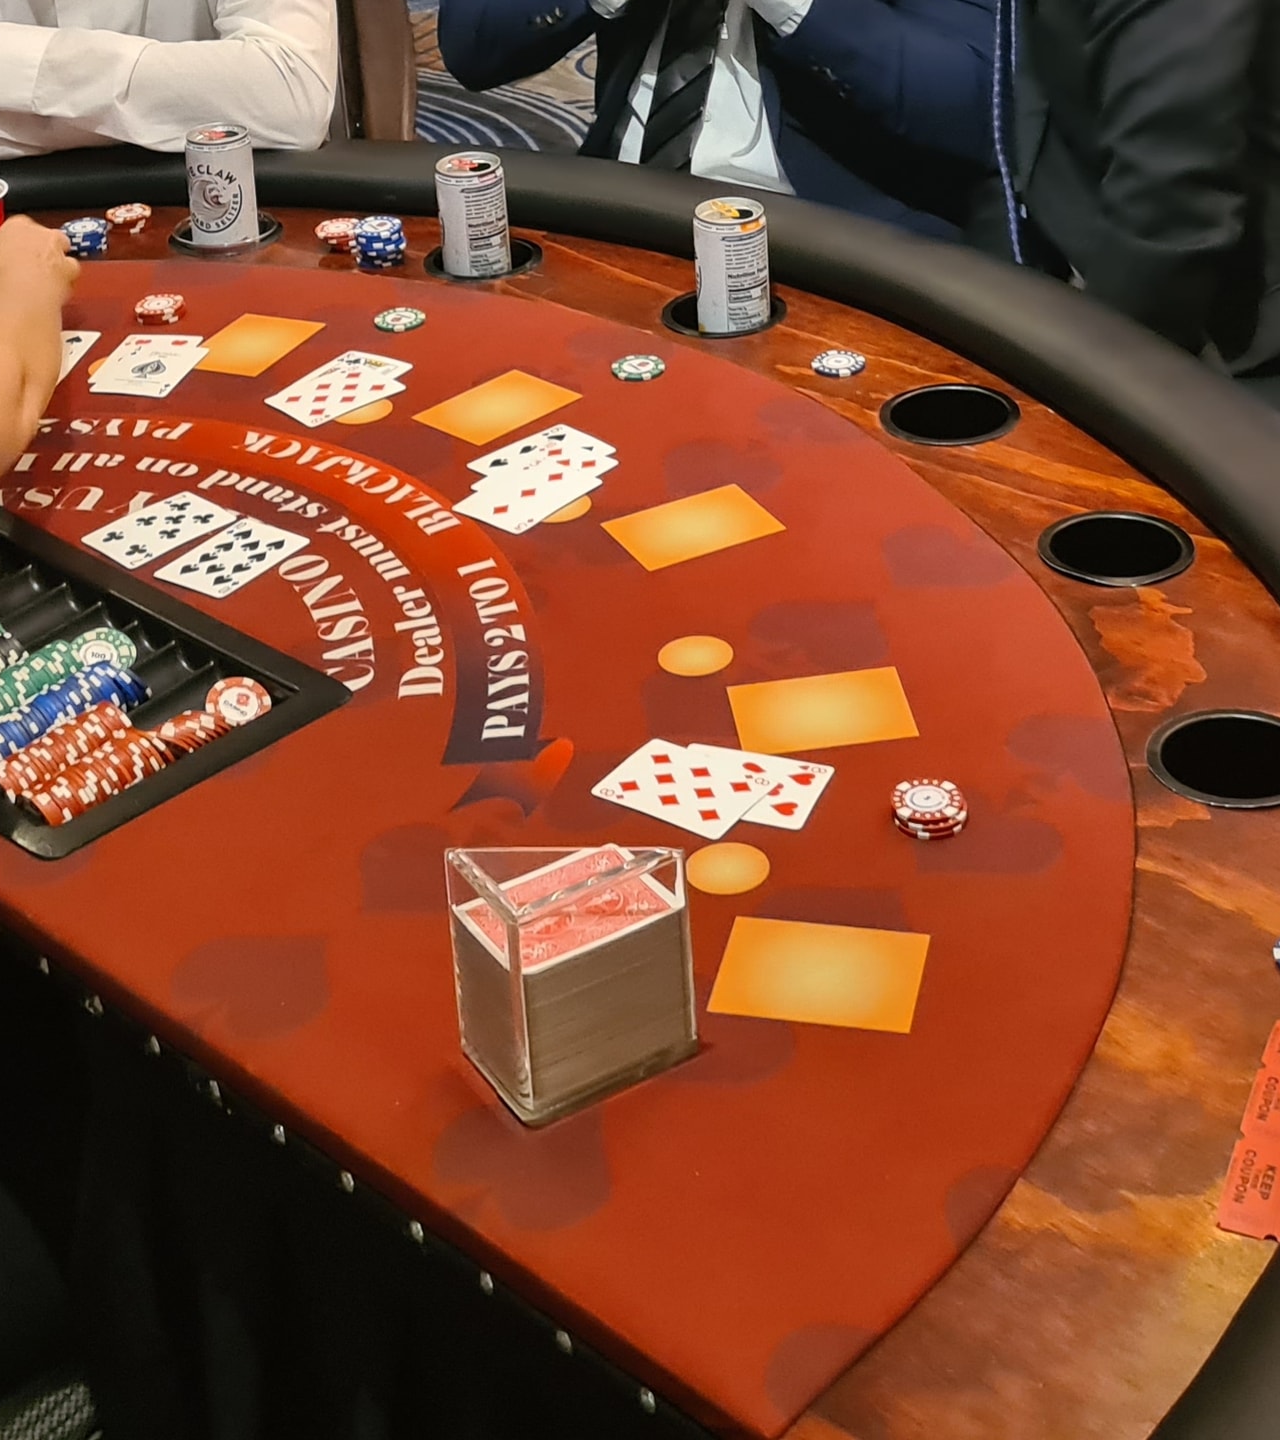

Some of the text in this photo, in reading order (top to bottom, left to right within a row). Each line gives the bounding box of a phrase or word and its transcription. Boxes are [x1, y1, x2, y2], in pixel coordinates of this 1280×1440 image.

[196, 164, 237, 185] CLAW
[215, 192, 239, 229] SELTZER
[65, 418, 193, 441] PAYS
[51, 452, 125, 472] all
[135, 456, 199, 477] on
[196, 468, 329, 519] stand
[232, 430, 462, 536] BLACKJACK
[316, 515, 411, 582] must
[278, 554, 376, 692] CASINO
[483, 624, 527, 647] 2
[91, 651, 107, 660] 100
[393, 587, 445, 700] Dealer
[481, 650, 530, 741] PAYS
[754, 777, 770, 787] 8
[810, 765, 828, 775] 8
[599, 788, 616, 798] 8
[1257, 1076, 1279, 1121] COUPON
[1232, 1149, 1257, 1204] COUPON
[1259, 1165, 1277, 1201] KEEP
